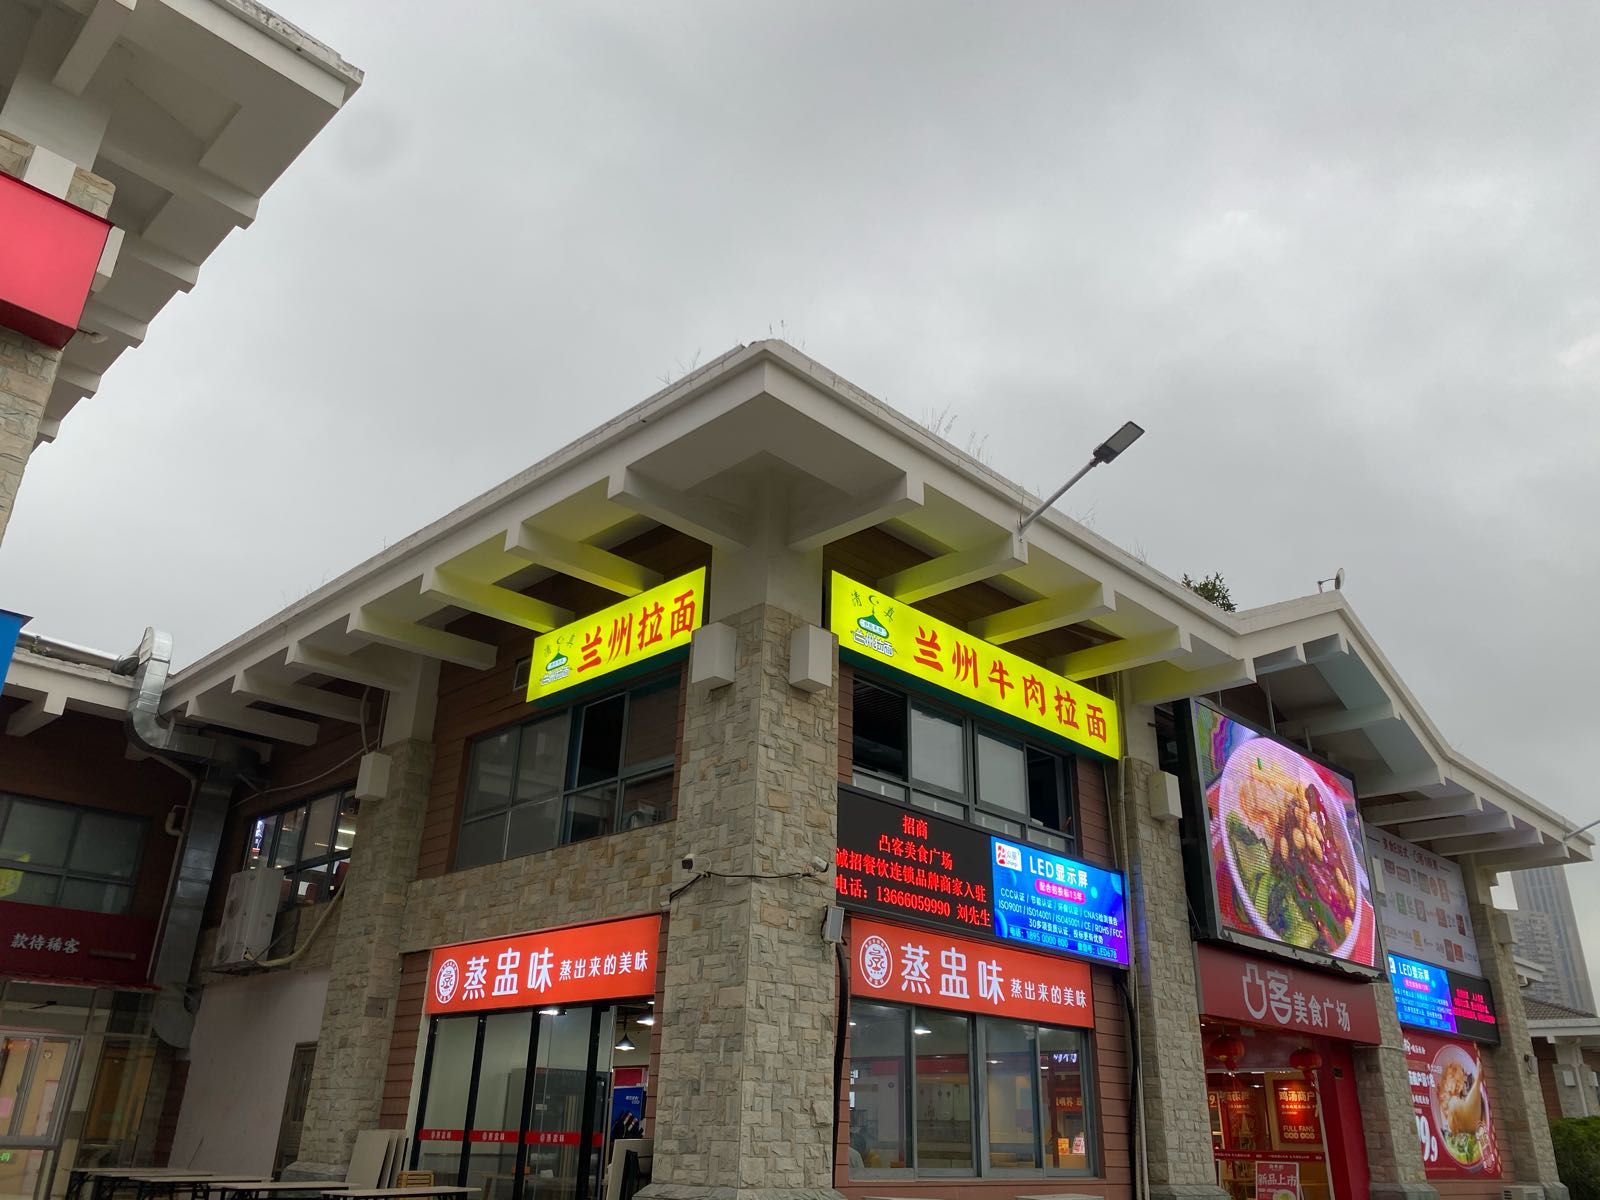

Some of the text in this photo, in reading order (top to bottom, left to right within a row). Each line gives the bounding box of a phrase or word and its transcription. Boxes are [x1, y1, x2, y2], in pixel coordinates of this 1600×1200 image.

[577, 589, 696, 672] 兰州拉面
[912, 625, 1107, 744] 兰州牛肉拉面
[902, 814, 928, 840] 招商
[878, 834, 953, 871] 凸客美食广场
[1029, 855, 1088, 888] LED显示屏
[876, 885, 951, 917] 13666059990
[956, 903, 992, 928] 刘先生
[10, 932, 81, 954] 款待稀客
[462, 946, 649, 1001] 蒸盅味 蒸出来的美味
[900, 942, 1087, 1009] 蒸盅味 蒸出来的美味
